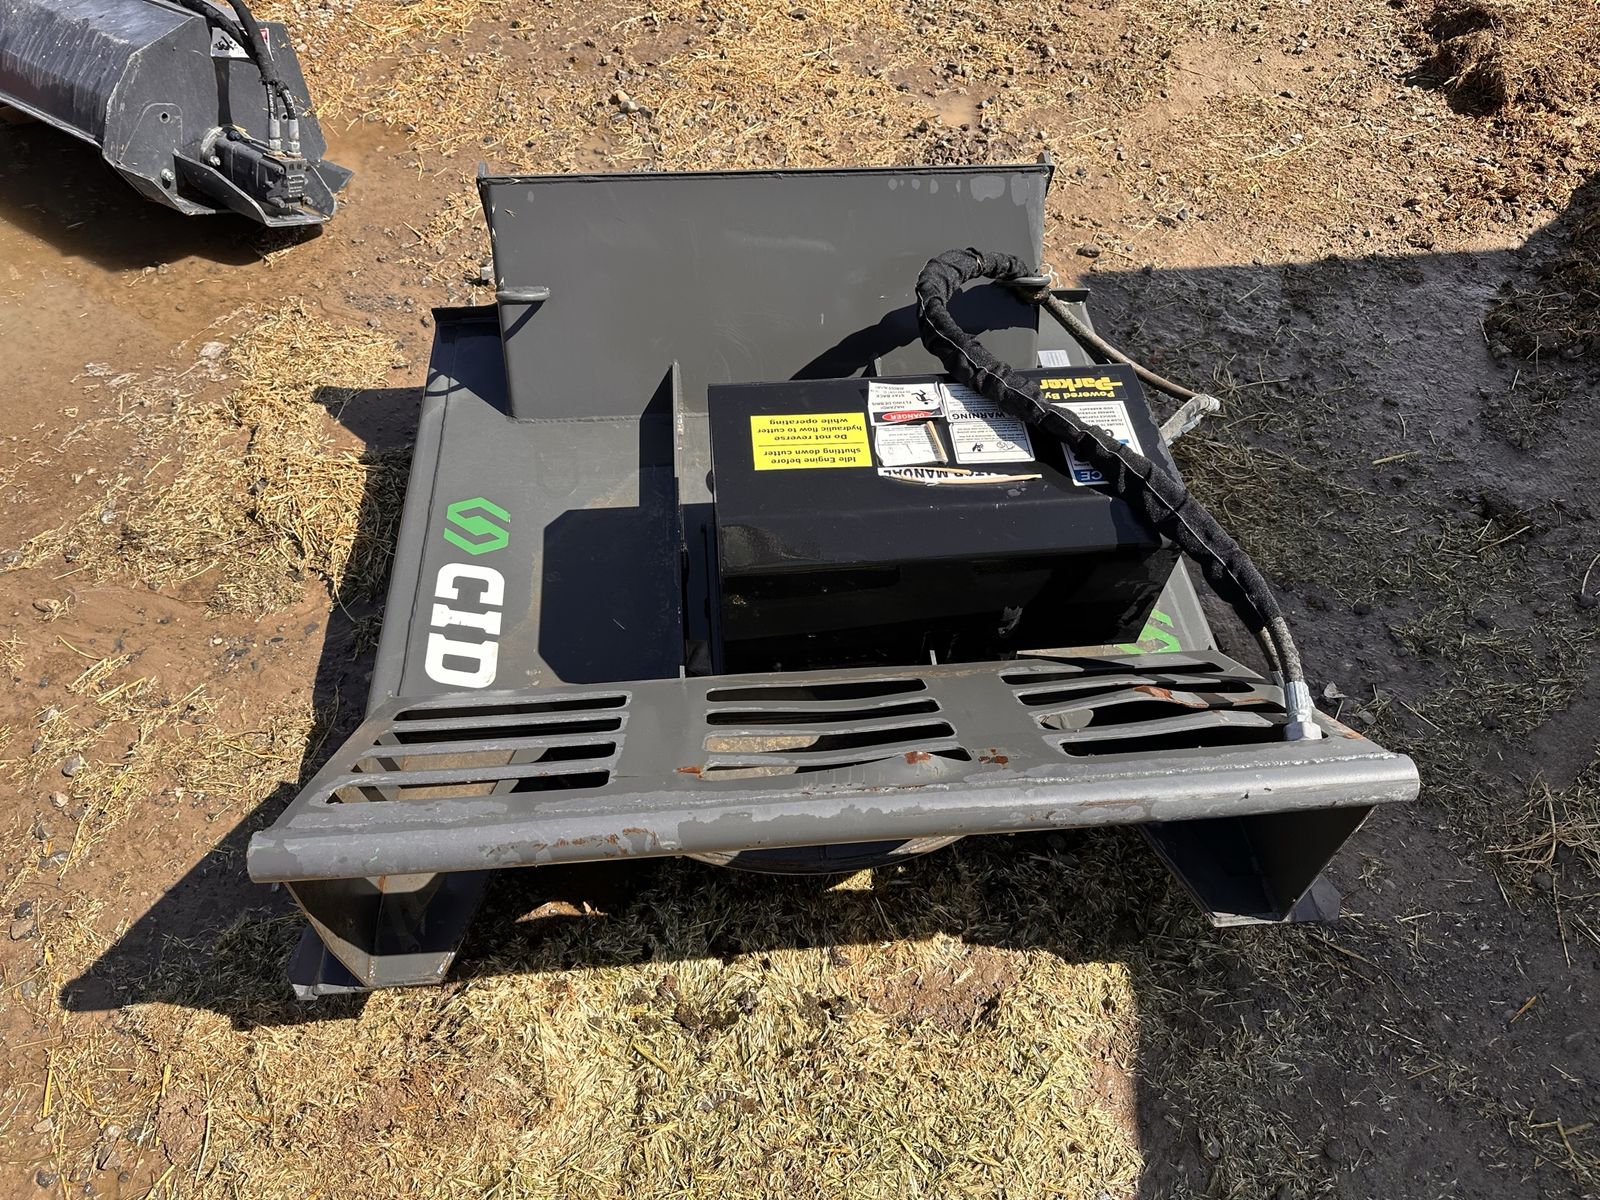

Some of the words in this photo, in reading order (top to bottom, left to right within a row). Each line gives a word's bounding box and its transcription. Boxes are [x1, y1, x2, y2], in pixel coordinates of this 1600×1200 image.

[1040, 377, 1122, 391] Parker
[884, 468, 948, 478] MANUAL
[424, 562, 505, 689] CID
